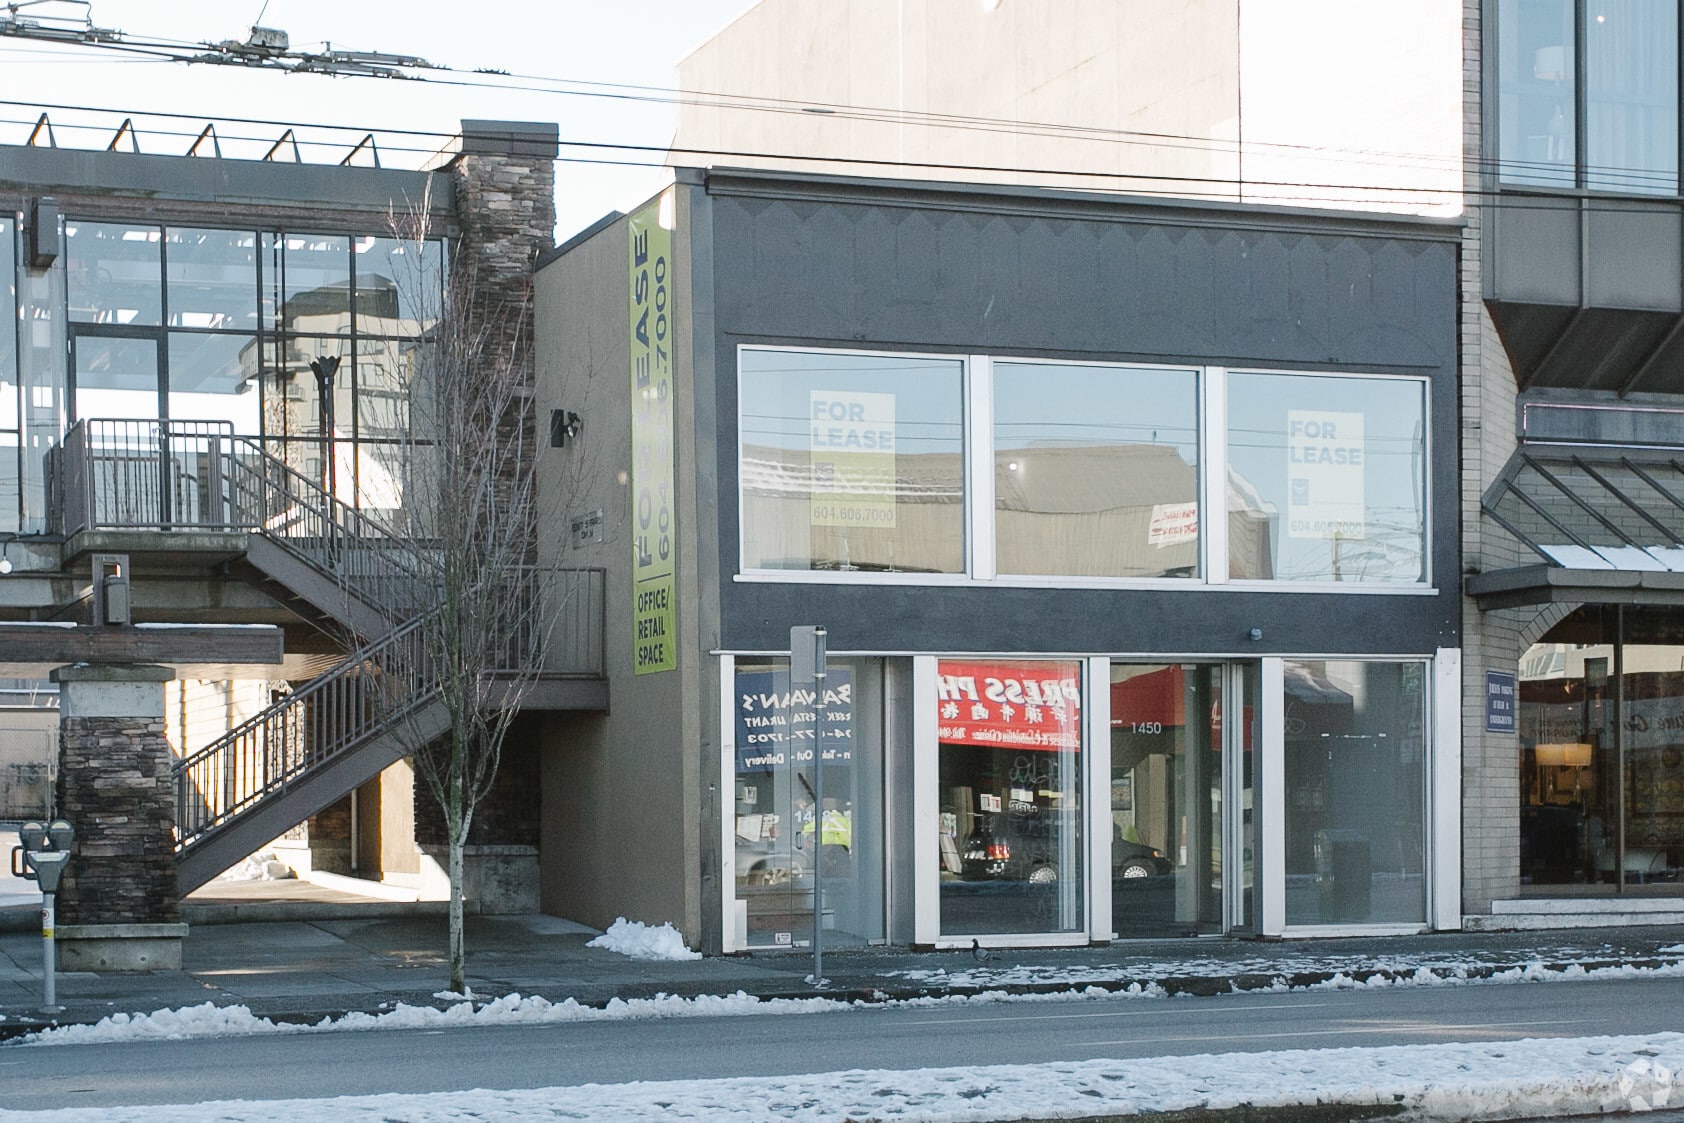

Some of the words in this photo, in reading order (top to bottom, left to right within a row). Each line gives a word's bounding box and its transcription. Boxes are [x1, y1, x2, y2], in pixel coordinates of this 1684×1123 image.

[634, 229, 650, 425] LEASE
[812, 400, 864, 421] FOR
[813, 427, 893, 449] LEASE
[1290, 420, 1336, 439] FOR
[1290, 446, 1362, 465] LEASE
[637, 443, 652, 568] FOR
[813, 506, 893, 521] 604.606.7000
[638, 585, 670, 613] OFFICE/
[638, 616, 665, 639] RETAIL
[638, 644, 664, 666] SPACE
[1131, 722, 1161, 735] 1450
